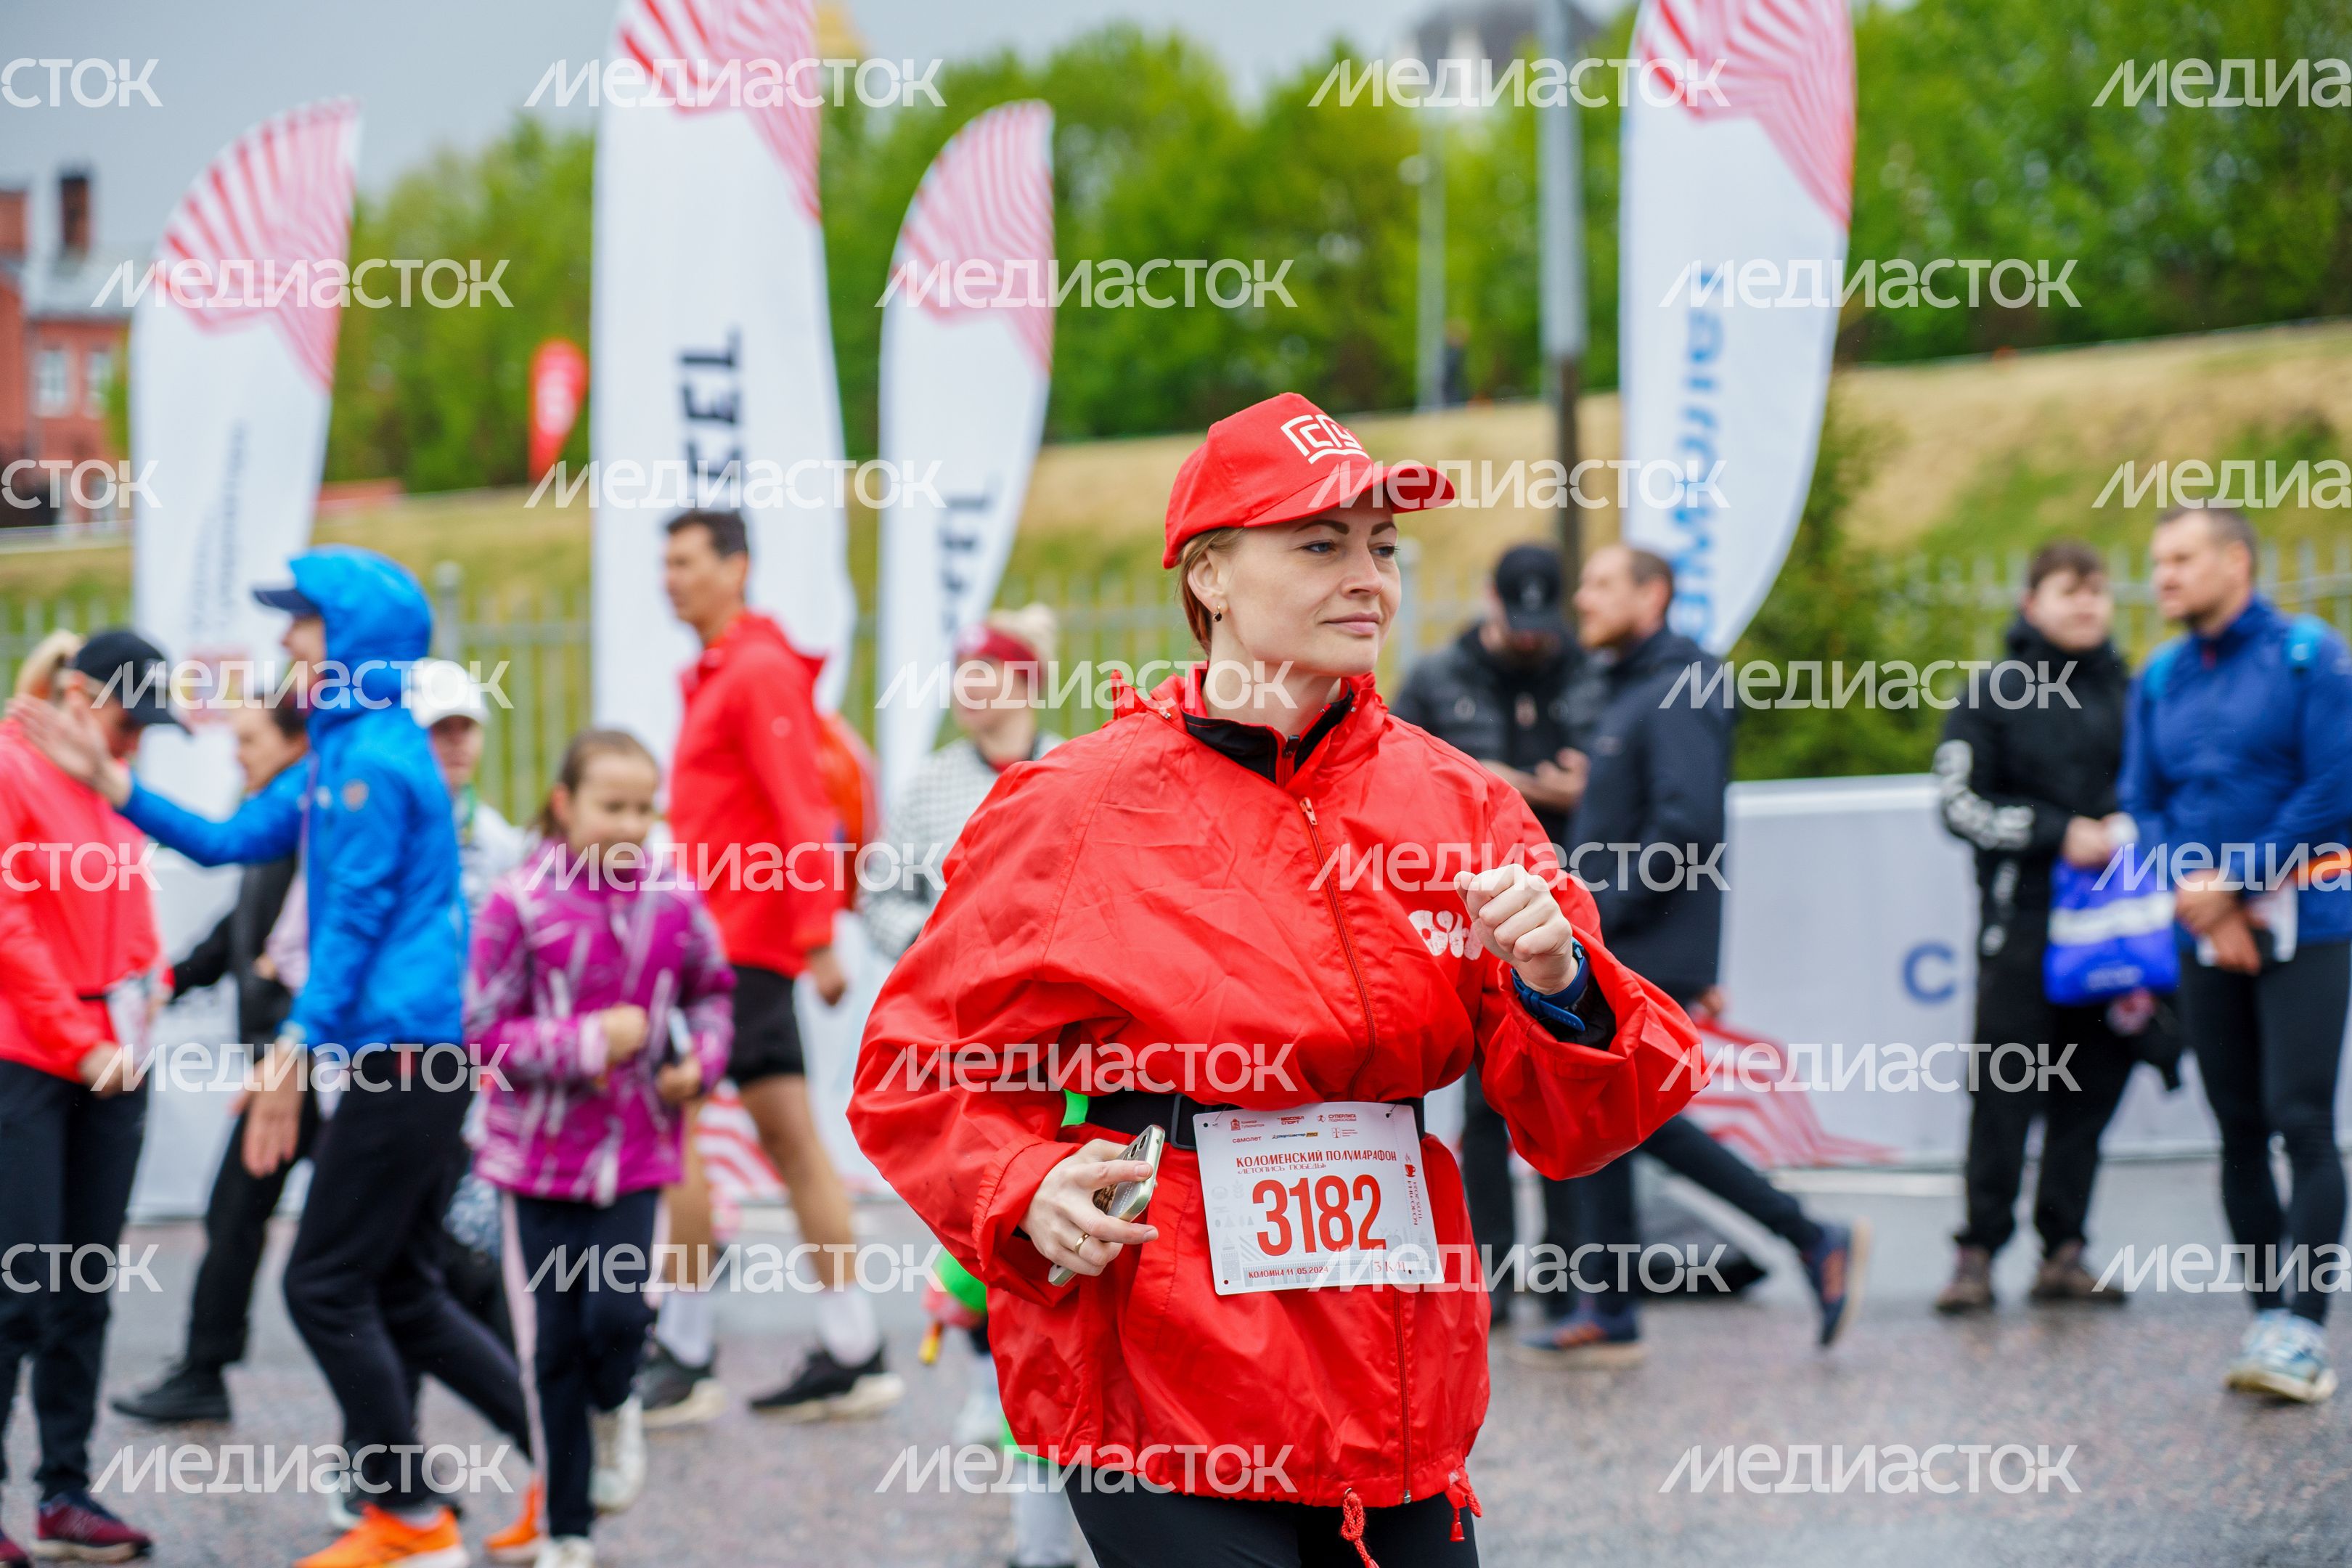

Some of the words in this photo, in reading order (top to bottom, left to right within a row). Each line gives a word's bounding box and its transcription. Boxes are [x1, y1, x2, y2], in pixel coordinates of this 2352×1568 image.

[1236, 1150, 1323, 1168] КОЛОМЕНСКИЙ
[1326, 1149, 1397, 1163] ПОЛУМАРАФОН
[1252, 1174, 1387, 1257] 3182
[1249, 1268, 1284, 1279] КОЛОМНА
